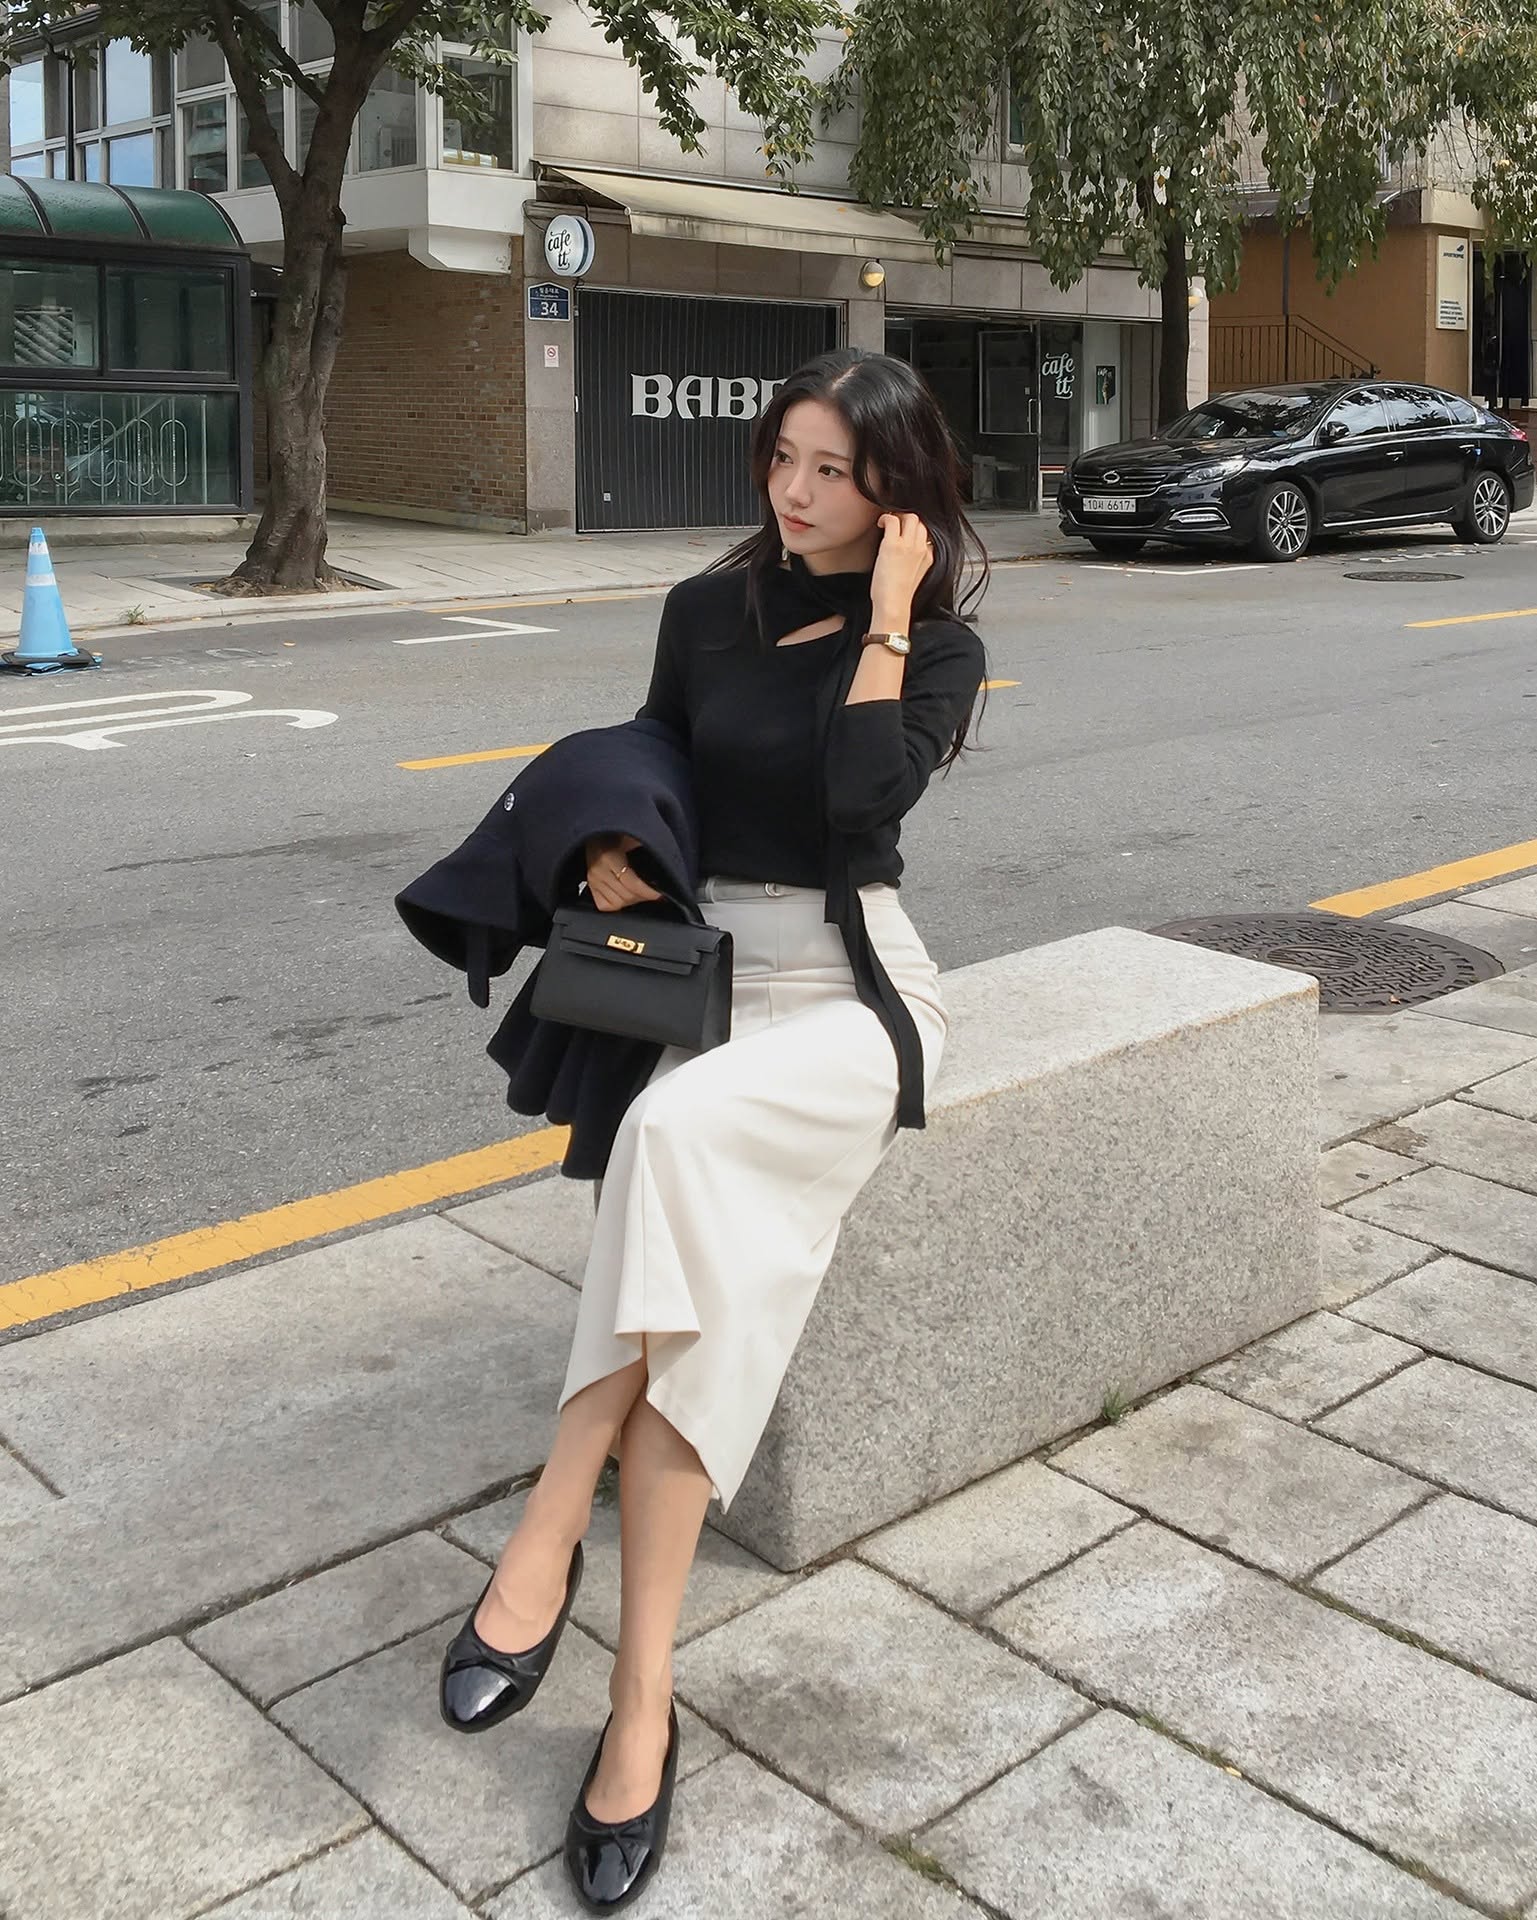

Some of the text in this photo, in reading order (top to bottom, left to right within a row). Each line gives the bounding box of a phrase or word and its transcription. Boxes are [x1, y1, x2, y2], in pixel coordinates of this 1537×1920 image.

[548, 229, 571, 252] cafe
[540, 301, 559, 316] 34
[1042, 353, 1075, 379] cafe
[1107, 500, 1131, 511] 6617
